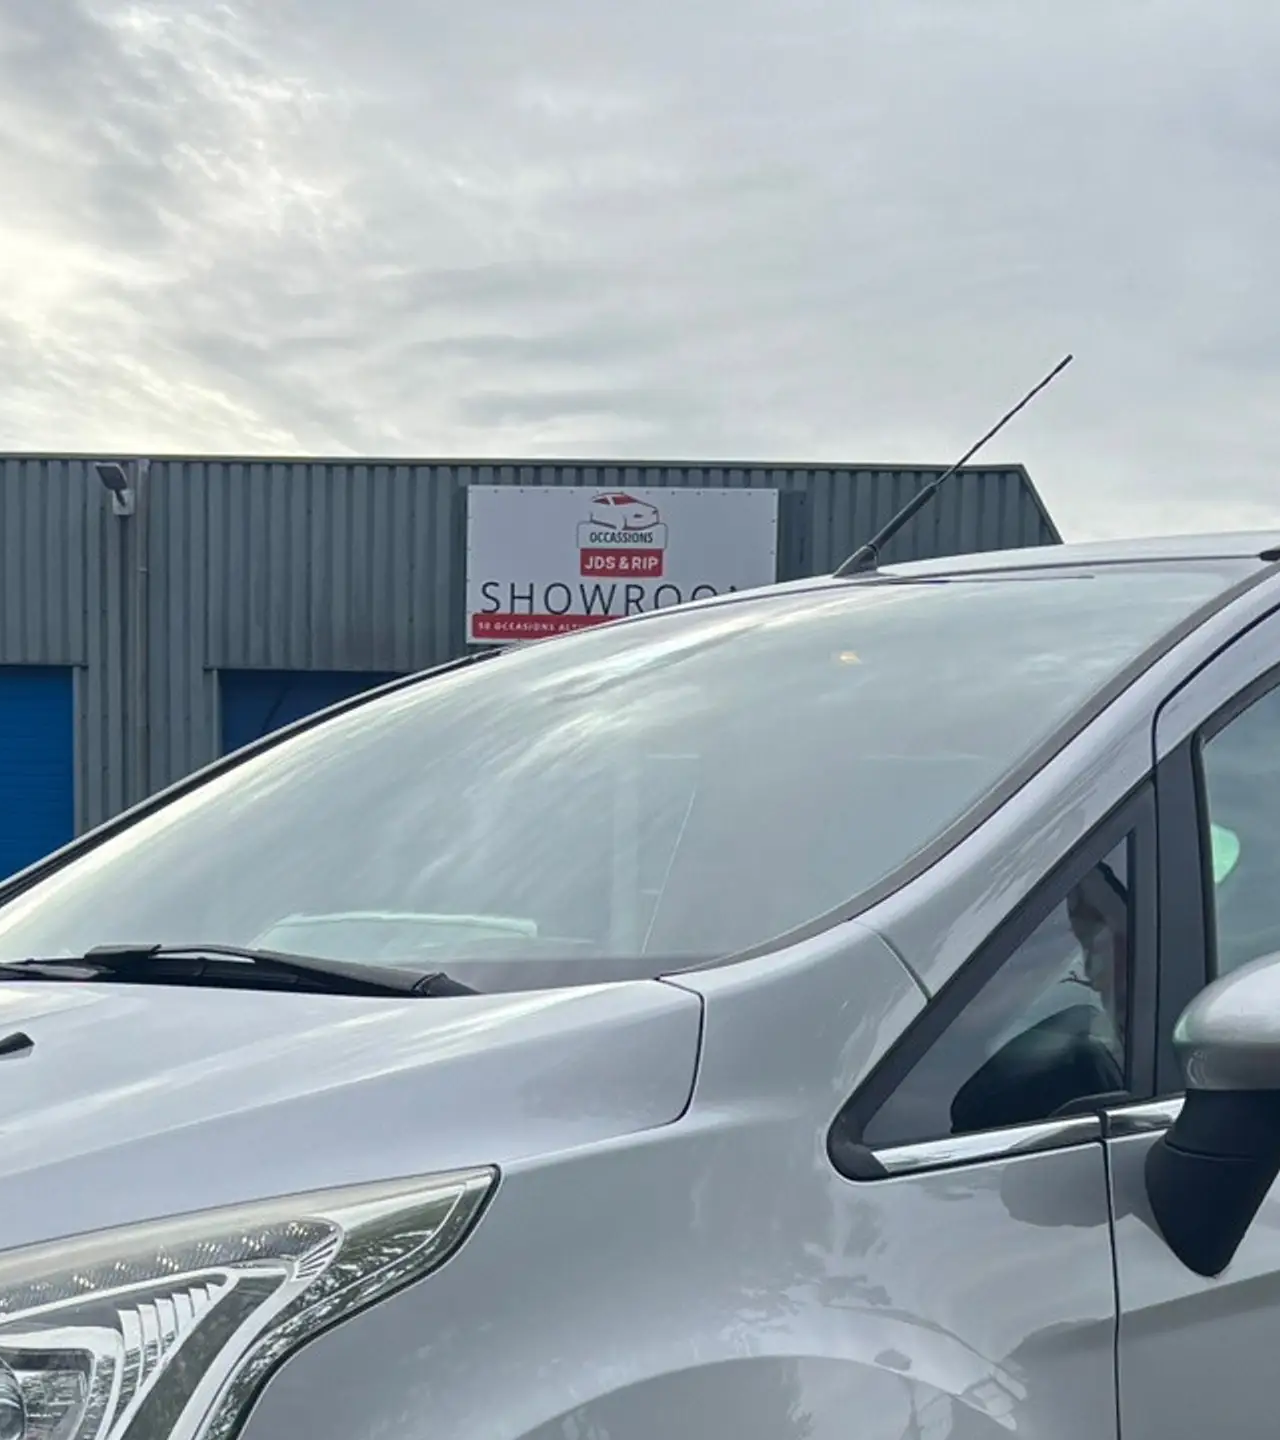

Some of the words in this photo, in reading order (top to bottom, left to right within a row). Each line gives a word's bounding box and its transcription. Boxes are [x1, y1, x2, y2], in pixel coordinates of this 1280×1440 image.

[589, 531, 653, 544] OCCASSIONS
[584, 556, 616, 570] JDS
[619, 556, 629, 570] &
[631, 556, 659, 570] RIP
